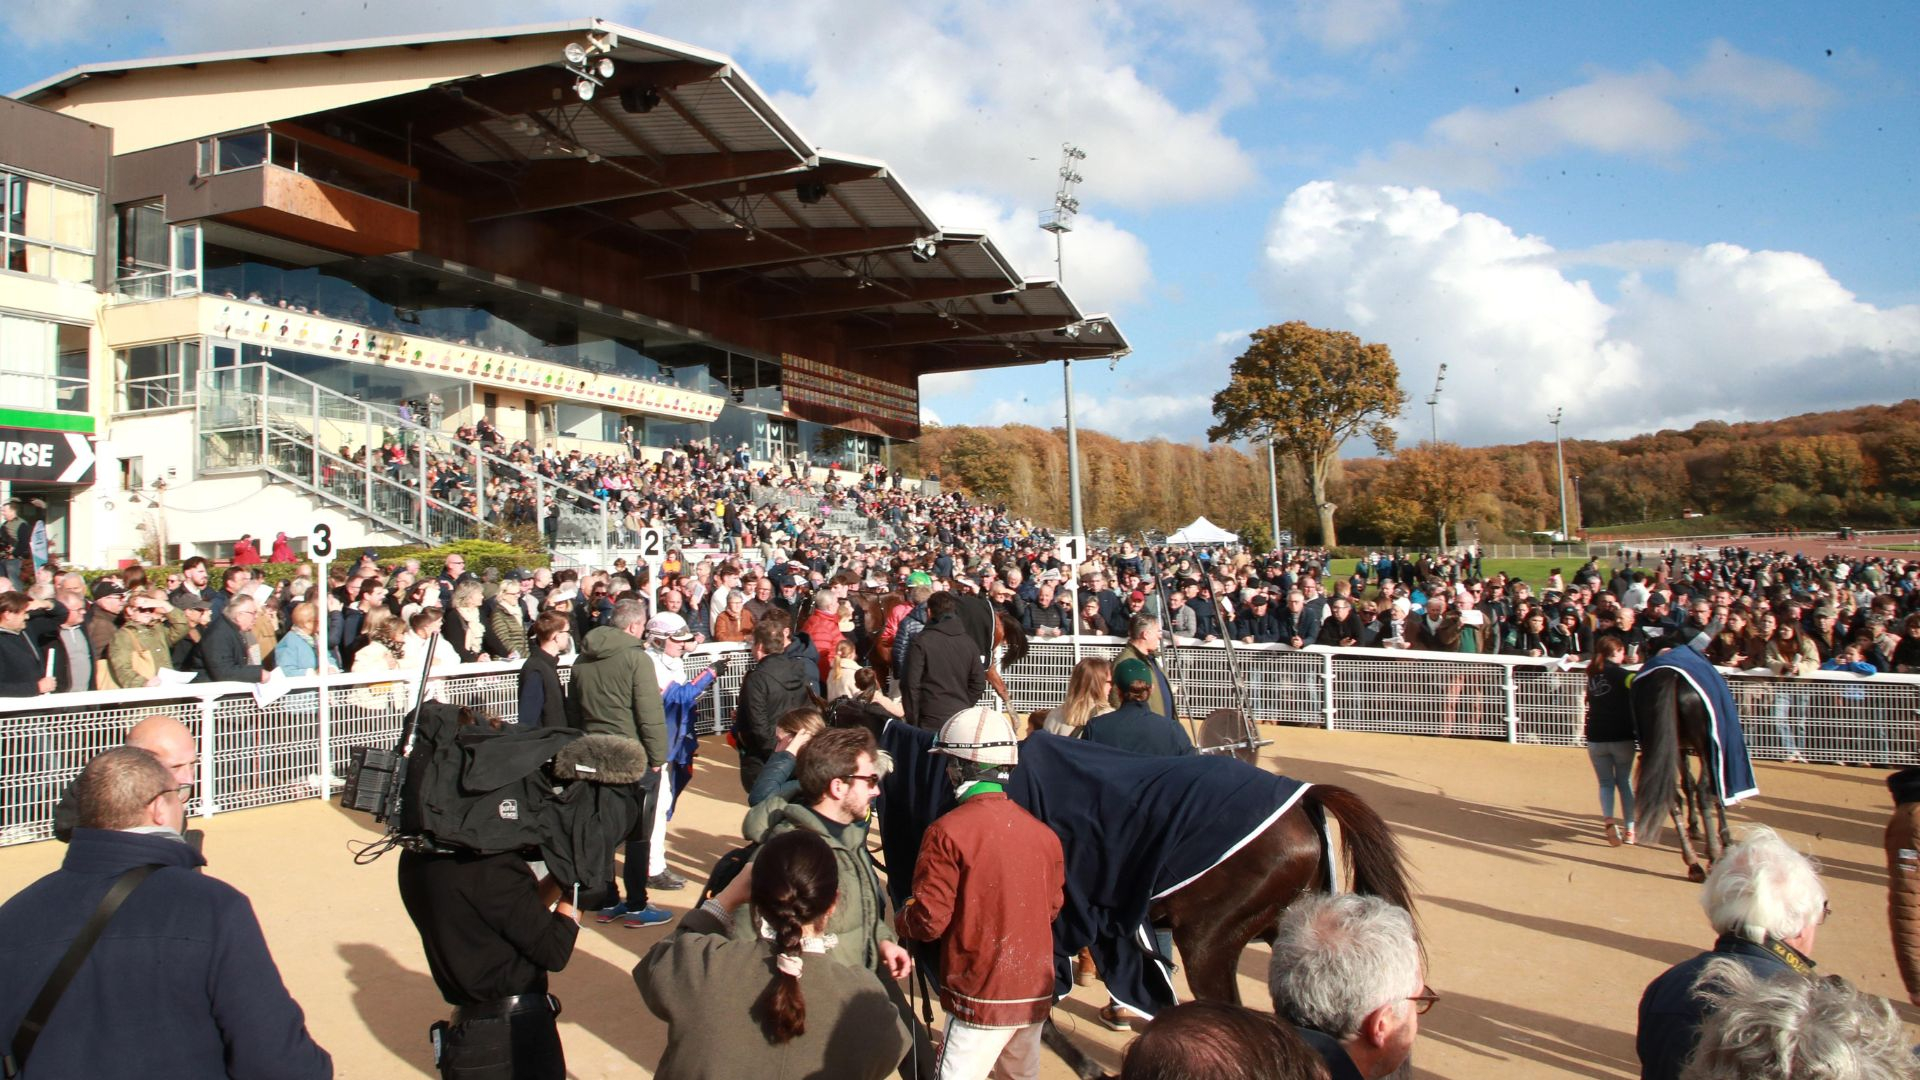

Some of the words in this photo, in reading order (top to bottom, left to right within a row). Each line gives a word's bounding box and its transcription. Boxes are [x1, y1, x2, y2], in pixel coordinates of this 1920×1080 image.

[313, 523, 331, 557] 3
[645, 530, 659, 555] 2
[1066, 539, 1076, 559] 1
